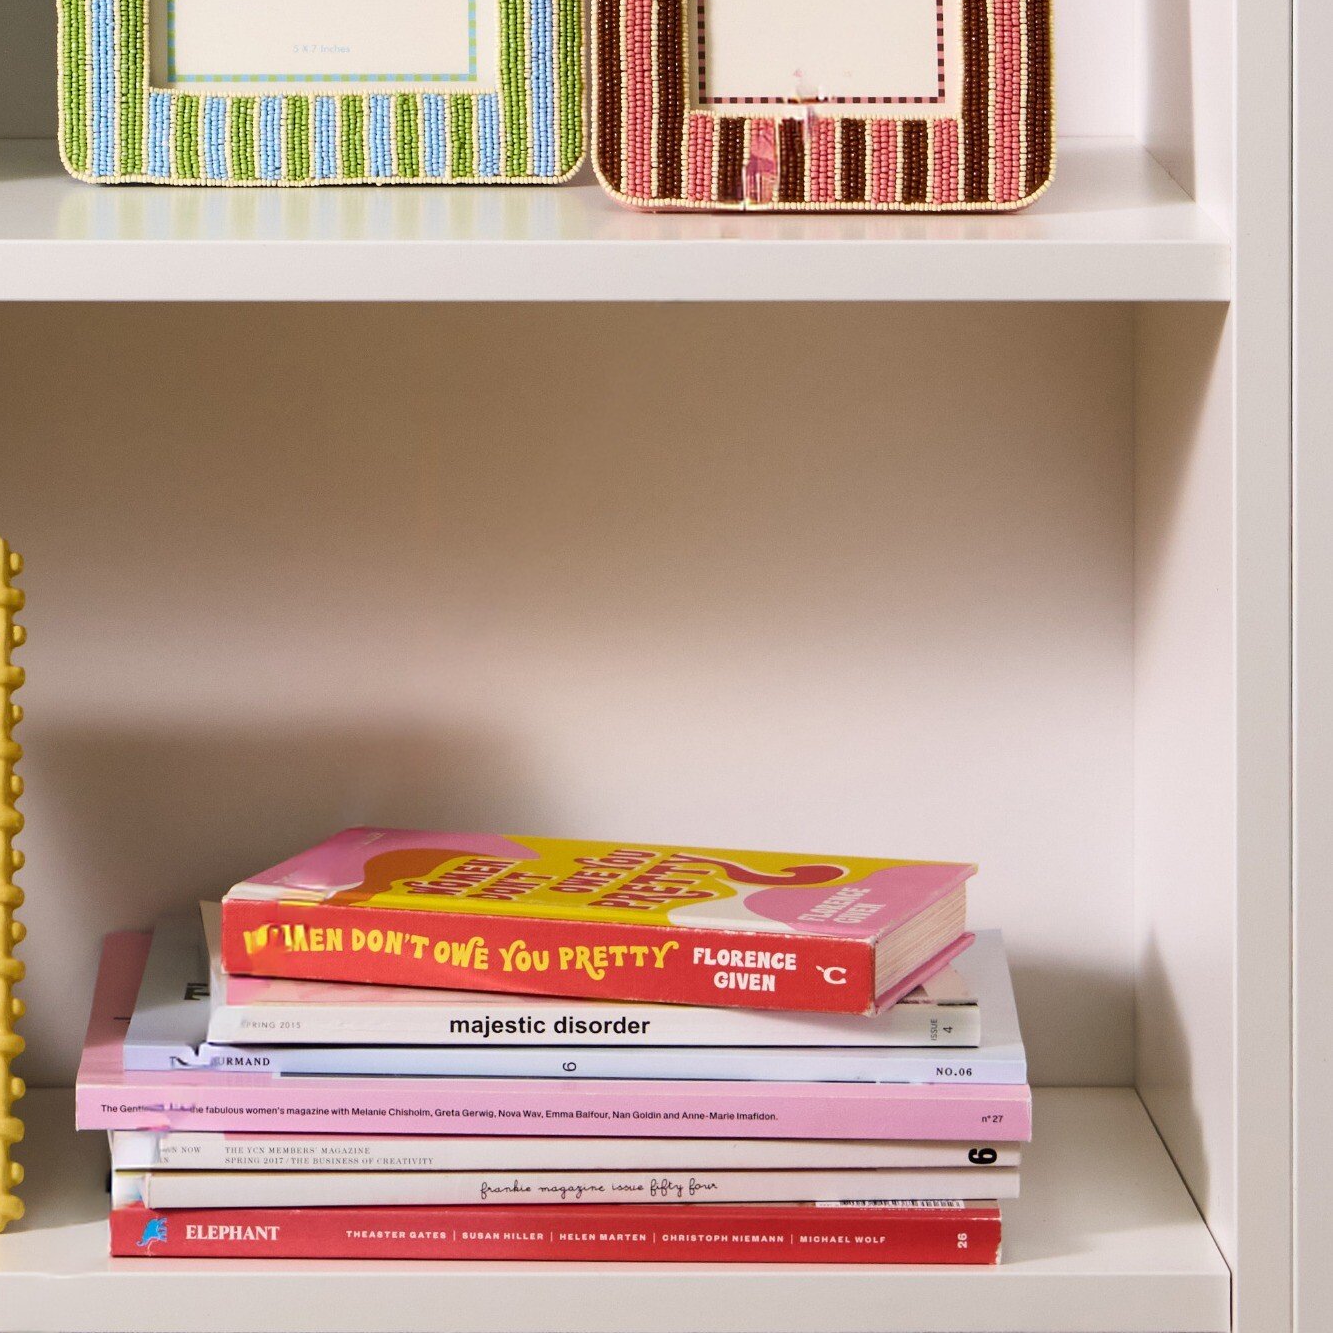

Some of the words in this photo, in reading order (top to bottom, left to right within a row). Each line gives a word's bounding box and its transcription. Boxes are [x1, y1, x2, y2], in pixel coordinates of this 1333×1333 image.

[351, 929, 429, 959] DON'T
[434, 937, 489, 970] OWE
[499, 940, 550, 973] YOU
[559, 941, 679, 981] PRETTY
[693, 948, 797, 971] FLORENCE
[713, 971, 776, 992] GIVEN
[279, 1019, 302, 1030] 2015
[450, 1015, 546, 1040] majestic
[553, 1016, 651, 1034] disorder
[930, 1018, 938, 1041] ISSUE
[942, 1025, 953, 1034] 4
[936, 1067, 973, 1077] NO.06
[101, 1105, 118, 1113] The
[205, 1106, 244, 1114] fabulous
[245, 1106, 285, 1115] women's
[286, 1107, 329, 1118] magazine
[331, 1107, 350, 1116] with
[351, 1108, 387, 1116] Melanie
[388, 1108, 433, 1118] Chisholm,
[434, 1108, 461, 1117] Greta
[462, 1109, 497, 1119] Gerwig,
[498, 1109, 521, 1118] Nova
[523, 1110, 544, 1119] Wav,
[545, 1110, 574, 1118] Emma
[576, 1110, 611, 1120] Balfour,
[612, 1111, 631, 1119] Nan
[633, 1110, 662, 1120] Goldin
[664, 1111, 680, 1120] and
[682, 1111, 735, 1120] Anne-Marie
[736, 1111, 778, 1121] Imafidon.
[225, 1146, 244, 1154] THE
[321, 1147, 371, 1155] MAGAZINE
[225, 1157, 261, 1165] SPRING
[263, 1157, 285, 1165] 2017
[291, 1157, 311, 1165] THE
[313, 1157, 361, 1165] BUSINESS
[362, 1157, 375, 1165] OF
[376, 1157, 434, 1165] CREATIVITY
[480, 1180, 531, 1199] frankie
[538, 1183, 606, 1199] magazine
[612, 1183, 644, 1192] issue
[650, 1178, 684, 1197] fifty
[688, 1178, 718, 1196] four
[185, 1224, 280, 1242] ELEPHANT
[346, 1230, 406, 1240] THEASTER
[409, 1231, 447, 1240] GATES
[462, 1231, 500, 1240] SUSAN
[503, 1232, 544, 1241] HILLER
[559, 1232, 596, 1241] HELEN
[599, 1233, 647, 1242] MARTEN
[662, 1234, 728, 1242] CHRISTOPH
[732, 1234, 784, 1243] NIEMANN
[799, 1235, 851, 1244] MICHAEL
[855, 1236, 886, 1245] WOLF
[957, 1232, 968, 1249] 26
